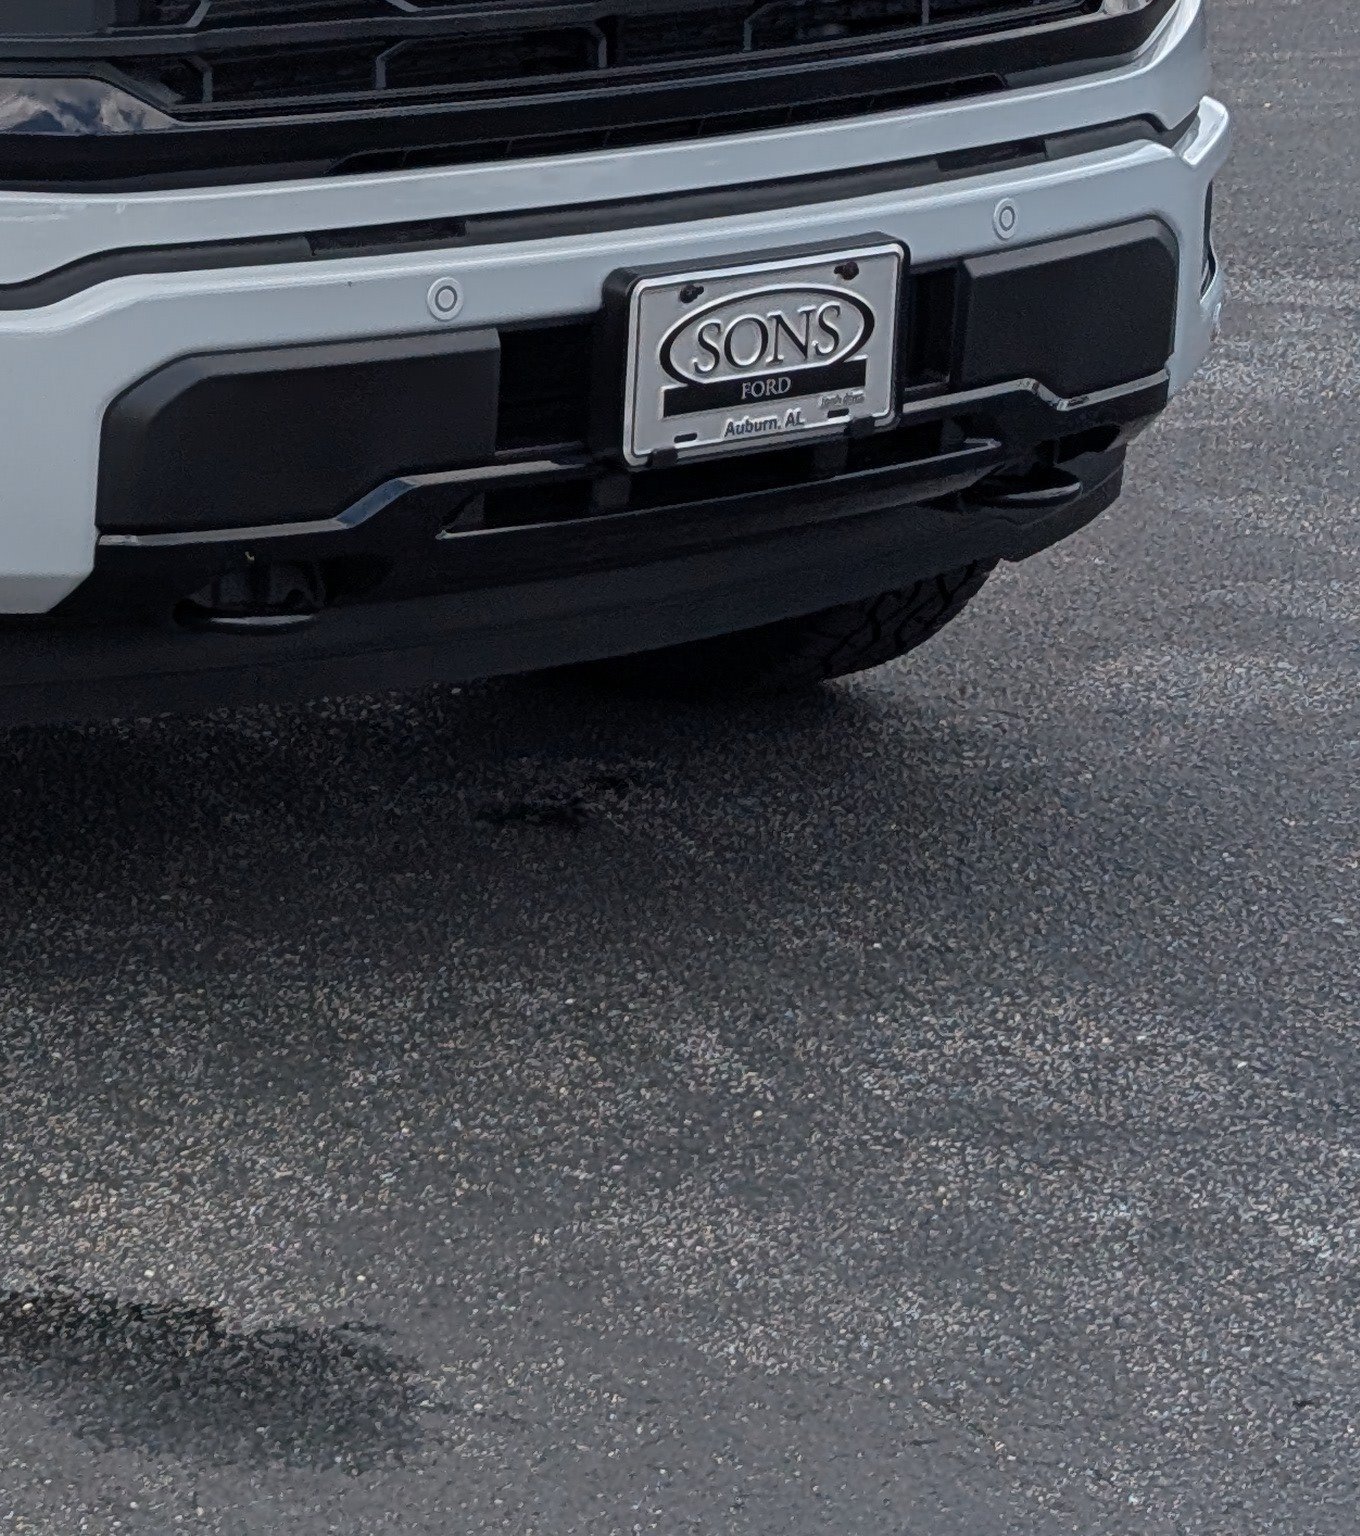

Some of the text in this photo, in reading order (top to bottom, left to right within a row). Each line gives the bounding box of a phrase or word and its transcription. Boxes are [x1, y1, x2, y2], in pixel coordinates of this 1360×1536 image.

[692, 300, 842, 375] SONS
[740, 376, 793, 401] FORD
[784, 407, 806, 428] AL
